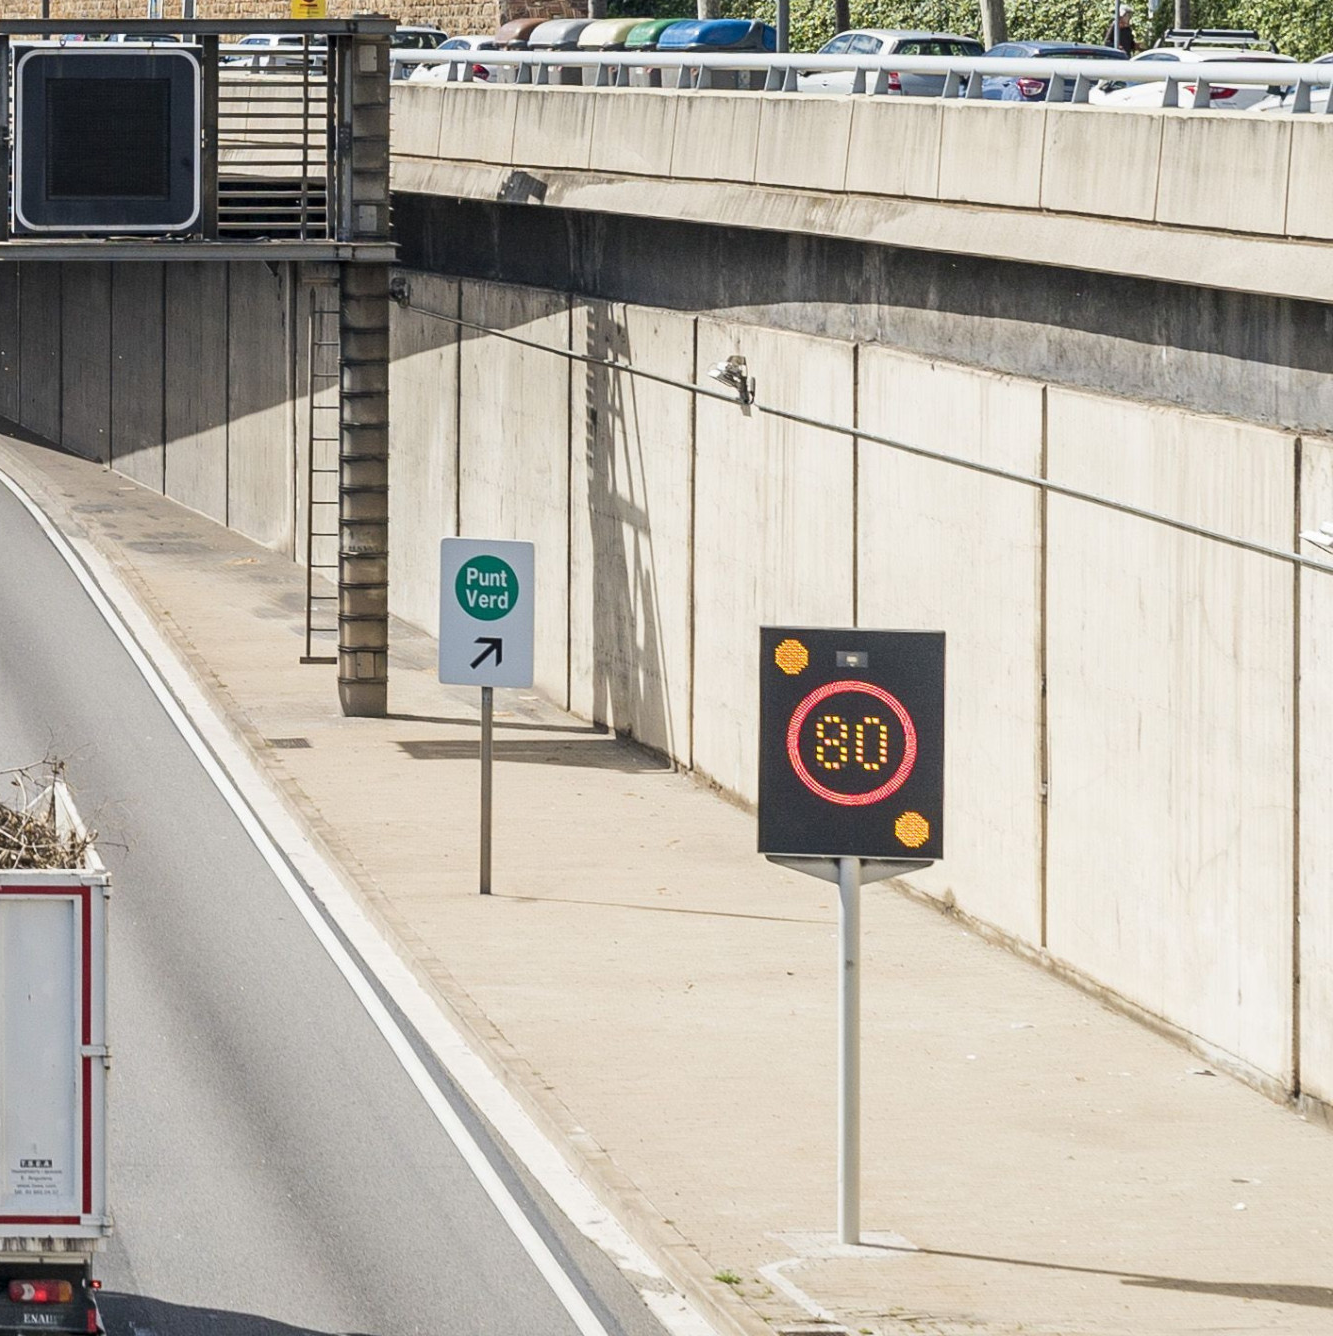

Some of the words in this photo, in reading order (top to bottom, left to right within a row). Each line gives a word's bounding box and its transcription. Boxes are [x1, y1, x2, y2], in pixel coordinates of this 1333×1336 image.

[466, 567, 508, 587] Punt
[465, 589, 509, 609] Verd
[816, 715, 888, 771] 80
